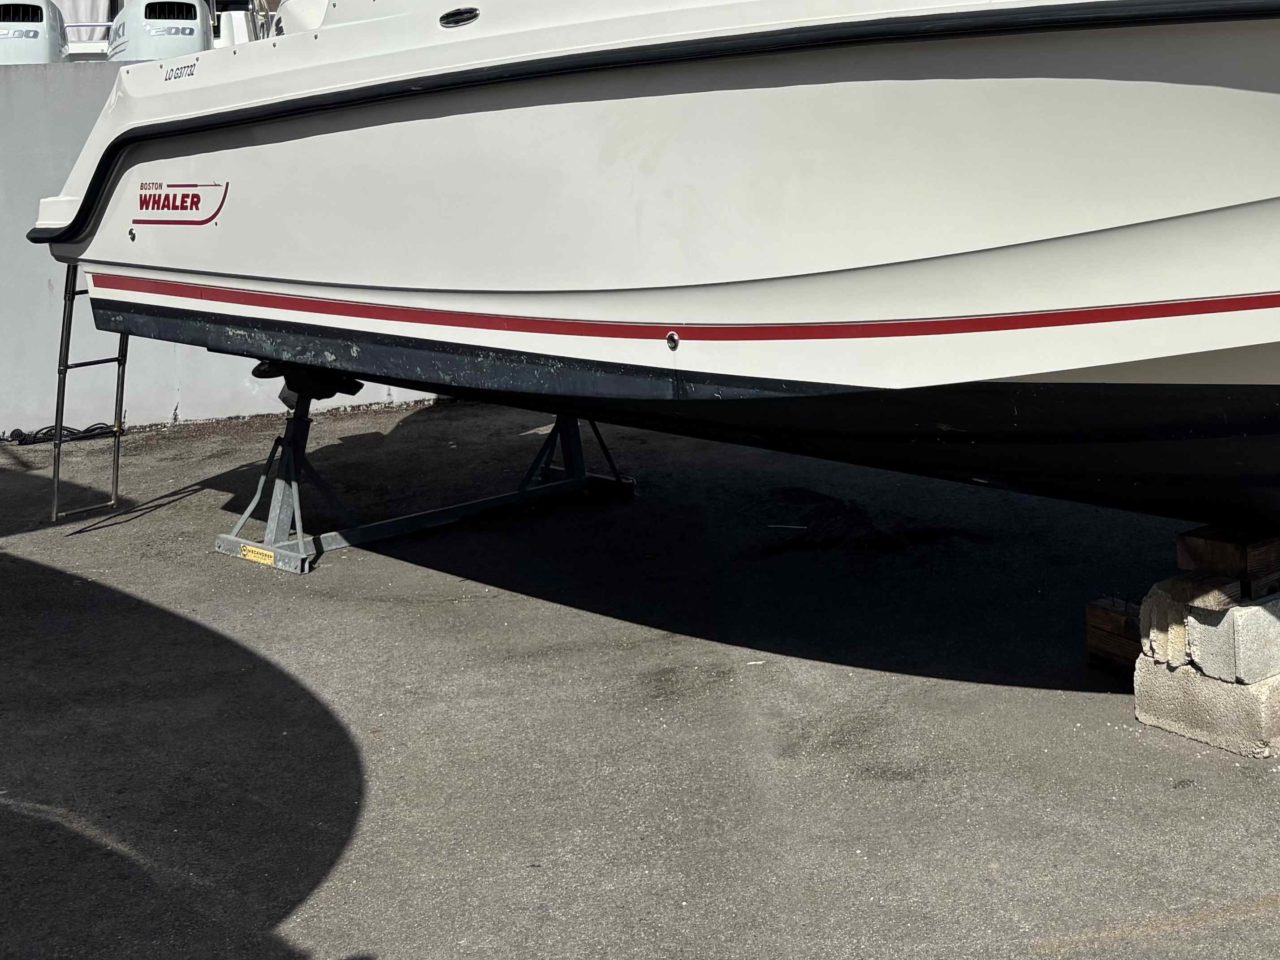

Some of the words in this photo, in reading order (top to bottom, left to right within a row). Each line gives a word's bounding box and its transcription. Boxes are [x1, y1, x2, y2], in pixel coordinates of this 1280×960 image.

[150, 26, 195, 37] 200
[164, 67, 174, 82] LO
[139, 182, 163, 191] BOSTON
[139, 193, 201, 211] WHALER
